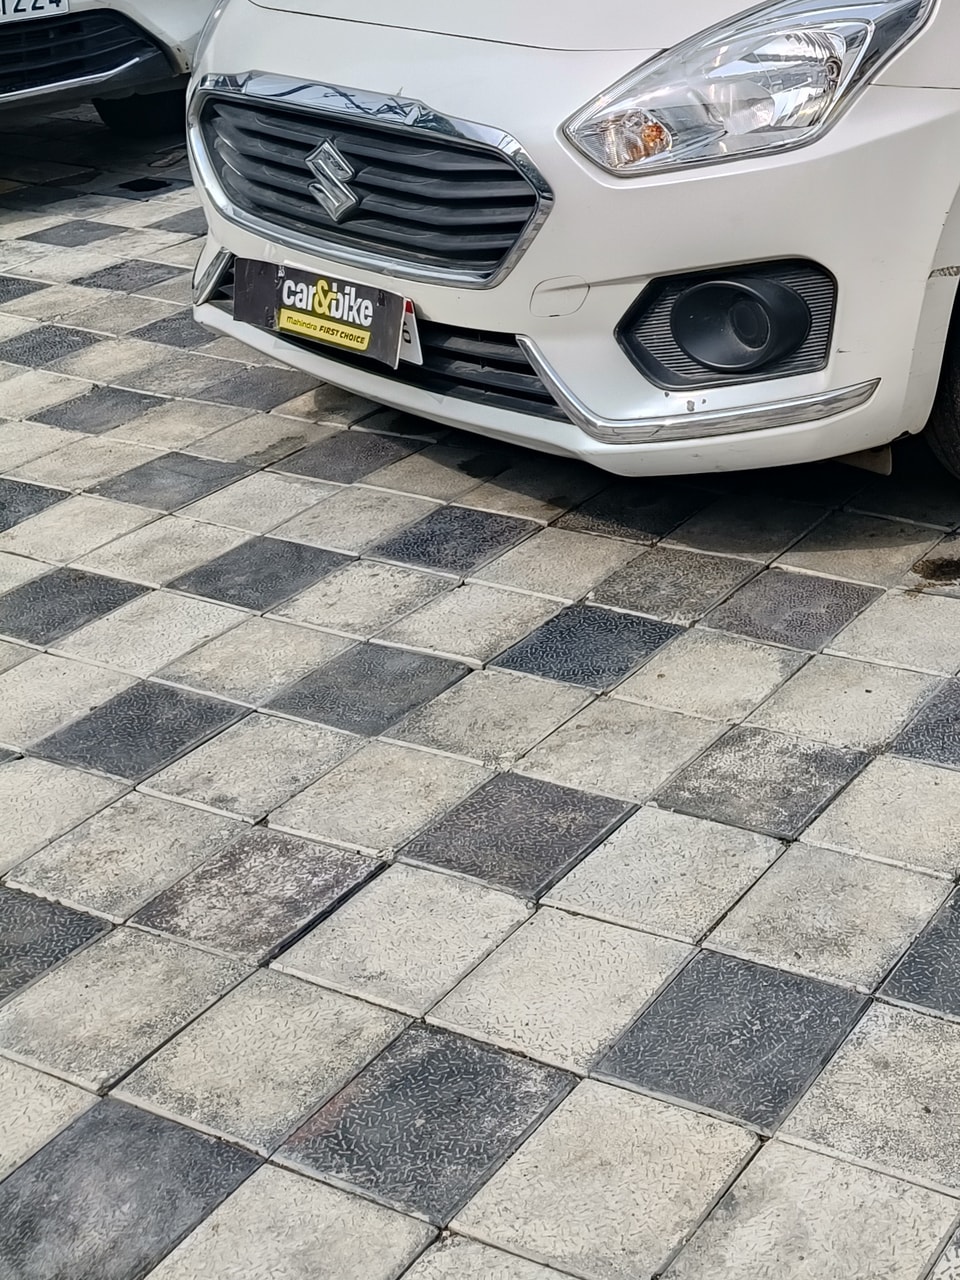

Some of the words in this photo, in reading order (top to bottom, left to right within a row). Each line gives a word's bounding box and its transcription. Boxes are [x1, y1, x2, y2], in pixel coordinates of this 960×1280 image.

[282, 279, 374, 327] car&bike
[319, 325, 340, 338] FIRST
[340, 331, 365, 345] CHOICE
